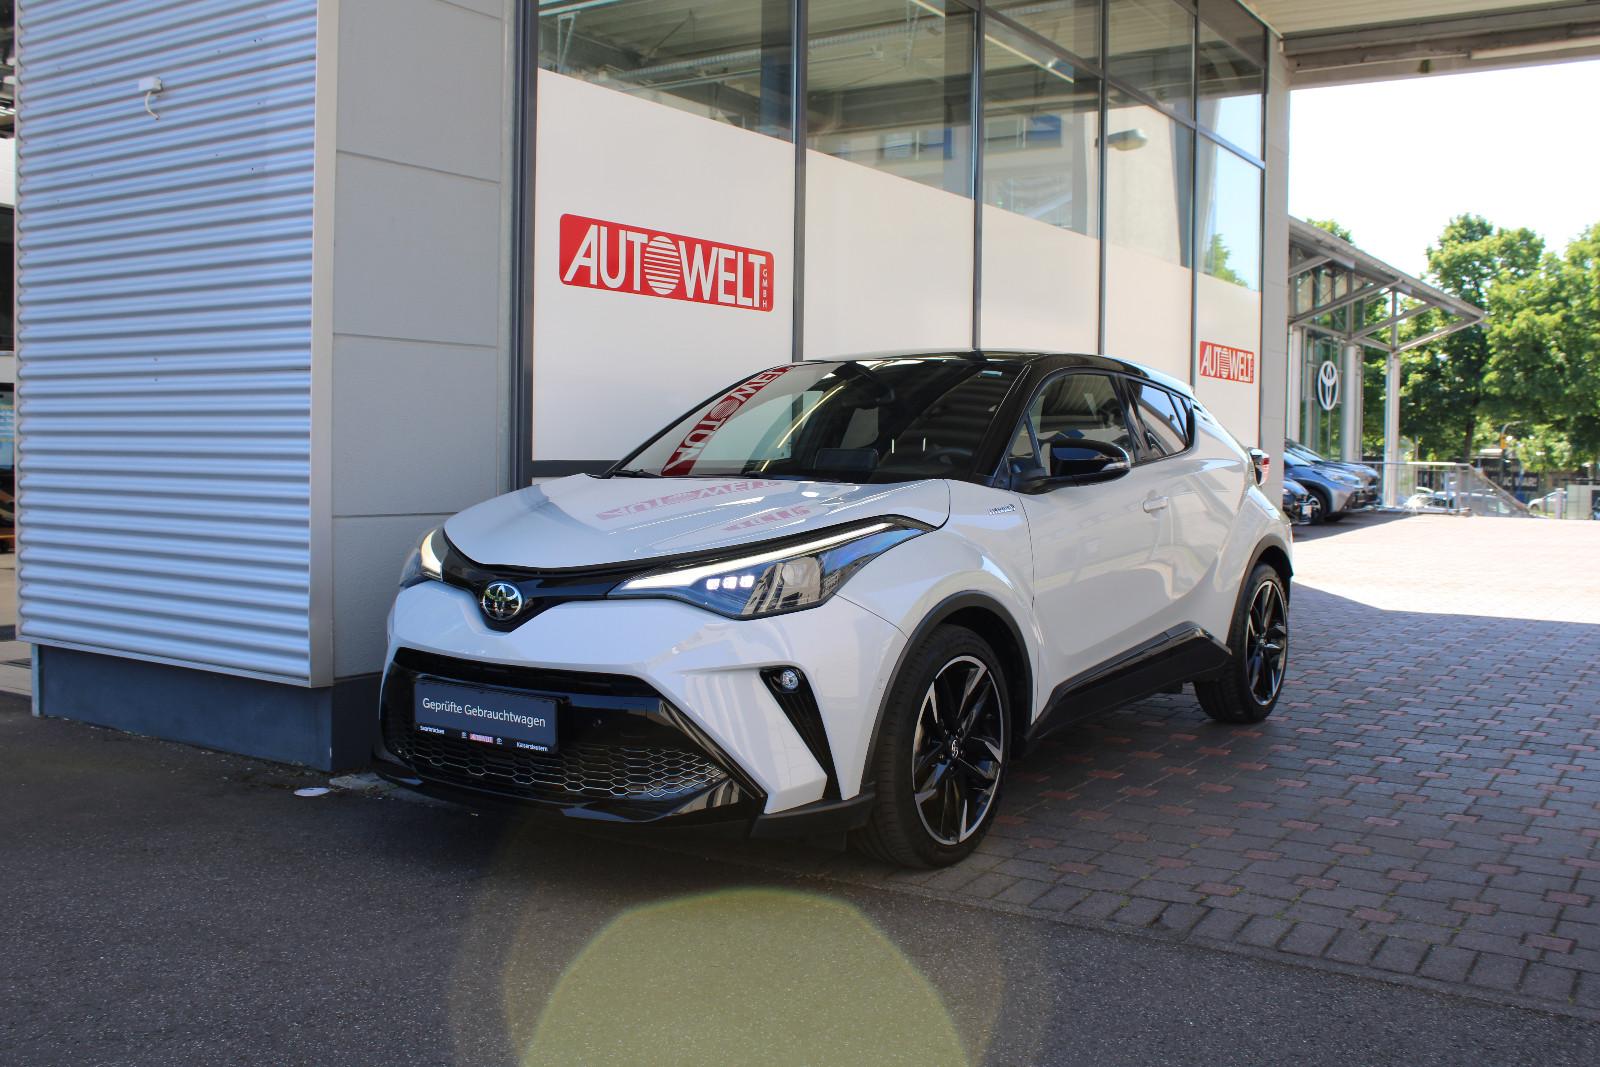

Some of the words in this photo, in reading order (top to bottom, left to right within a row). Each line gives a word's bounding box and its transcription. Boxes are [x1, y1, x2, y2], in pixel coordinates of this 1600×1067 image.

[563, 224, 766, 308] AUTOWELT
[1200, 345, 1252, 381] AUTOWELT
[422, 698, 462, 713] Geprüfte
[464, 704, 546, 728] Gebrauchtwagen
